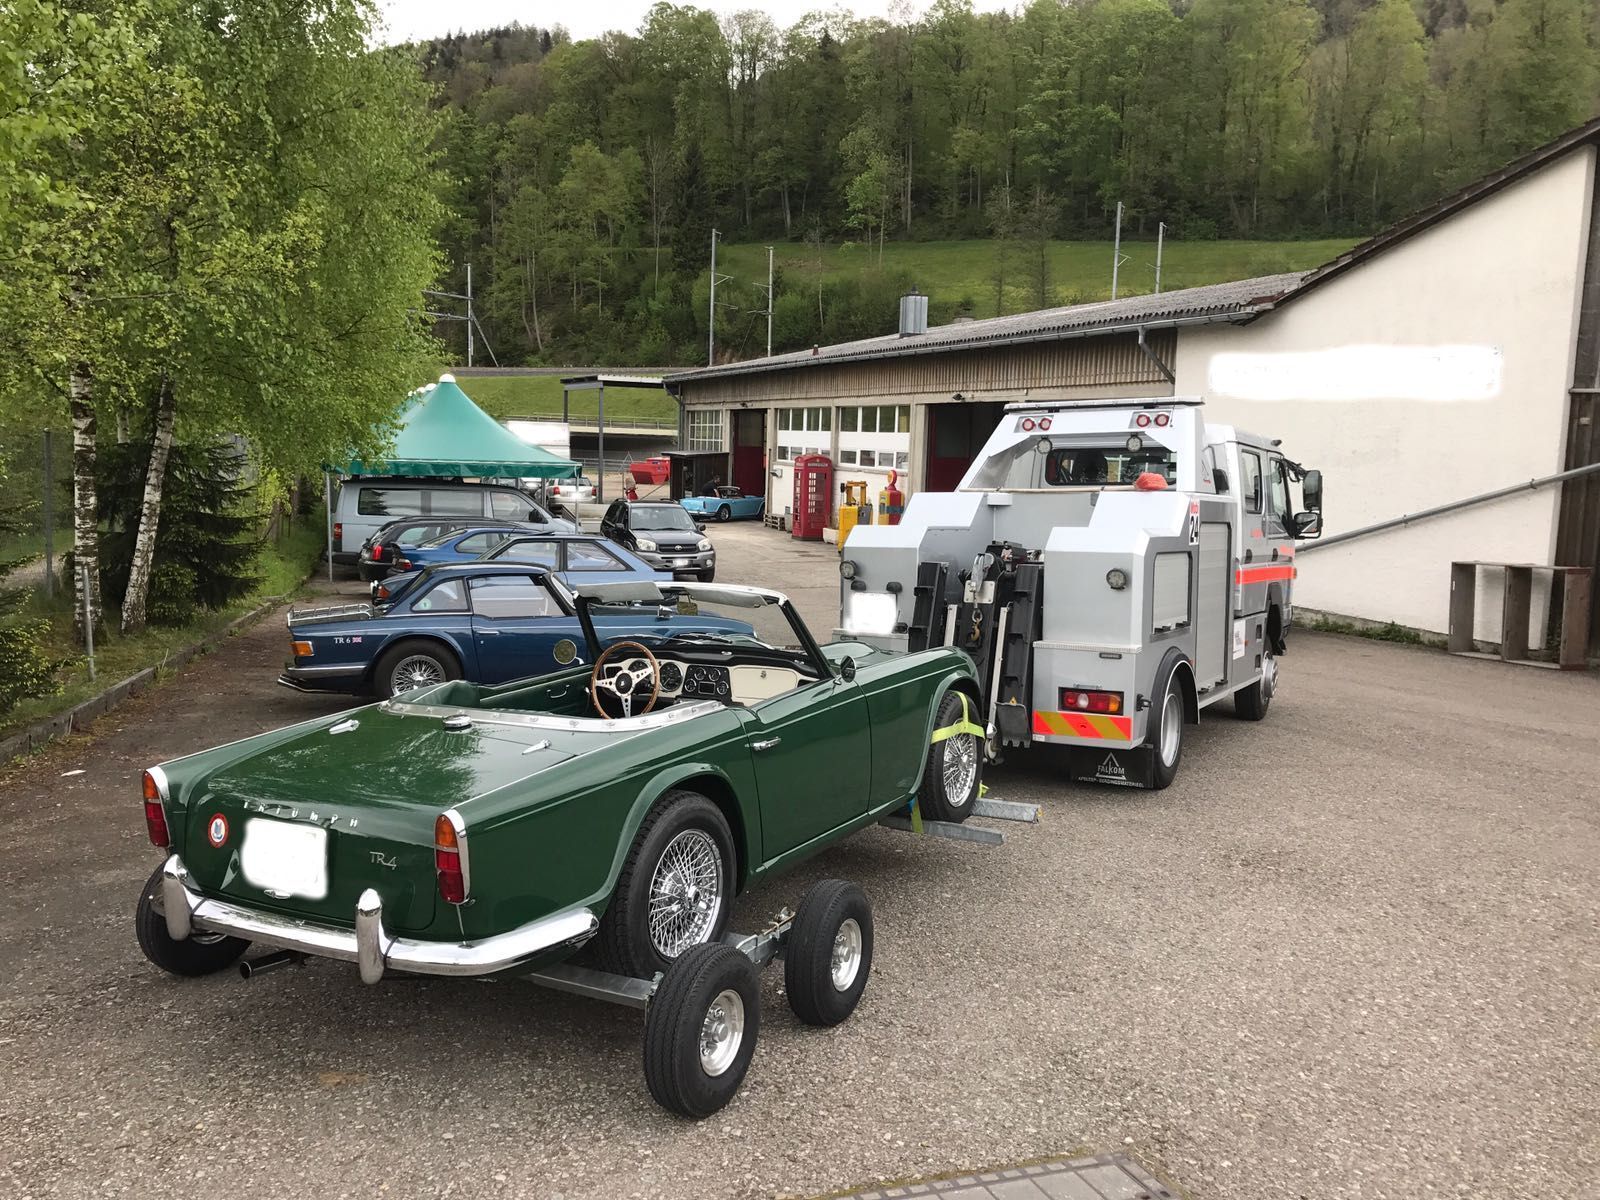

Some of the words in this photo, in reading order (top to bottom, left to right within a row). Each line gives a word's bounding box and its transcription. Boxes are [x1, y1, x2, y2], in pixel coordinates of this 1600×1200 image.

[1190, 515, 1199, 543] 24
[346, 636, 351, 644] 6
[1097, 761, 1125, 775] FALKOM
[243, 801, 359, 828] TRIUMPH
[369, 851, 398, 871] TR4
